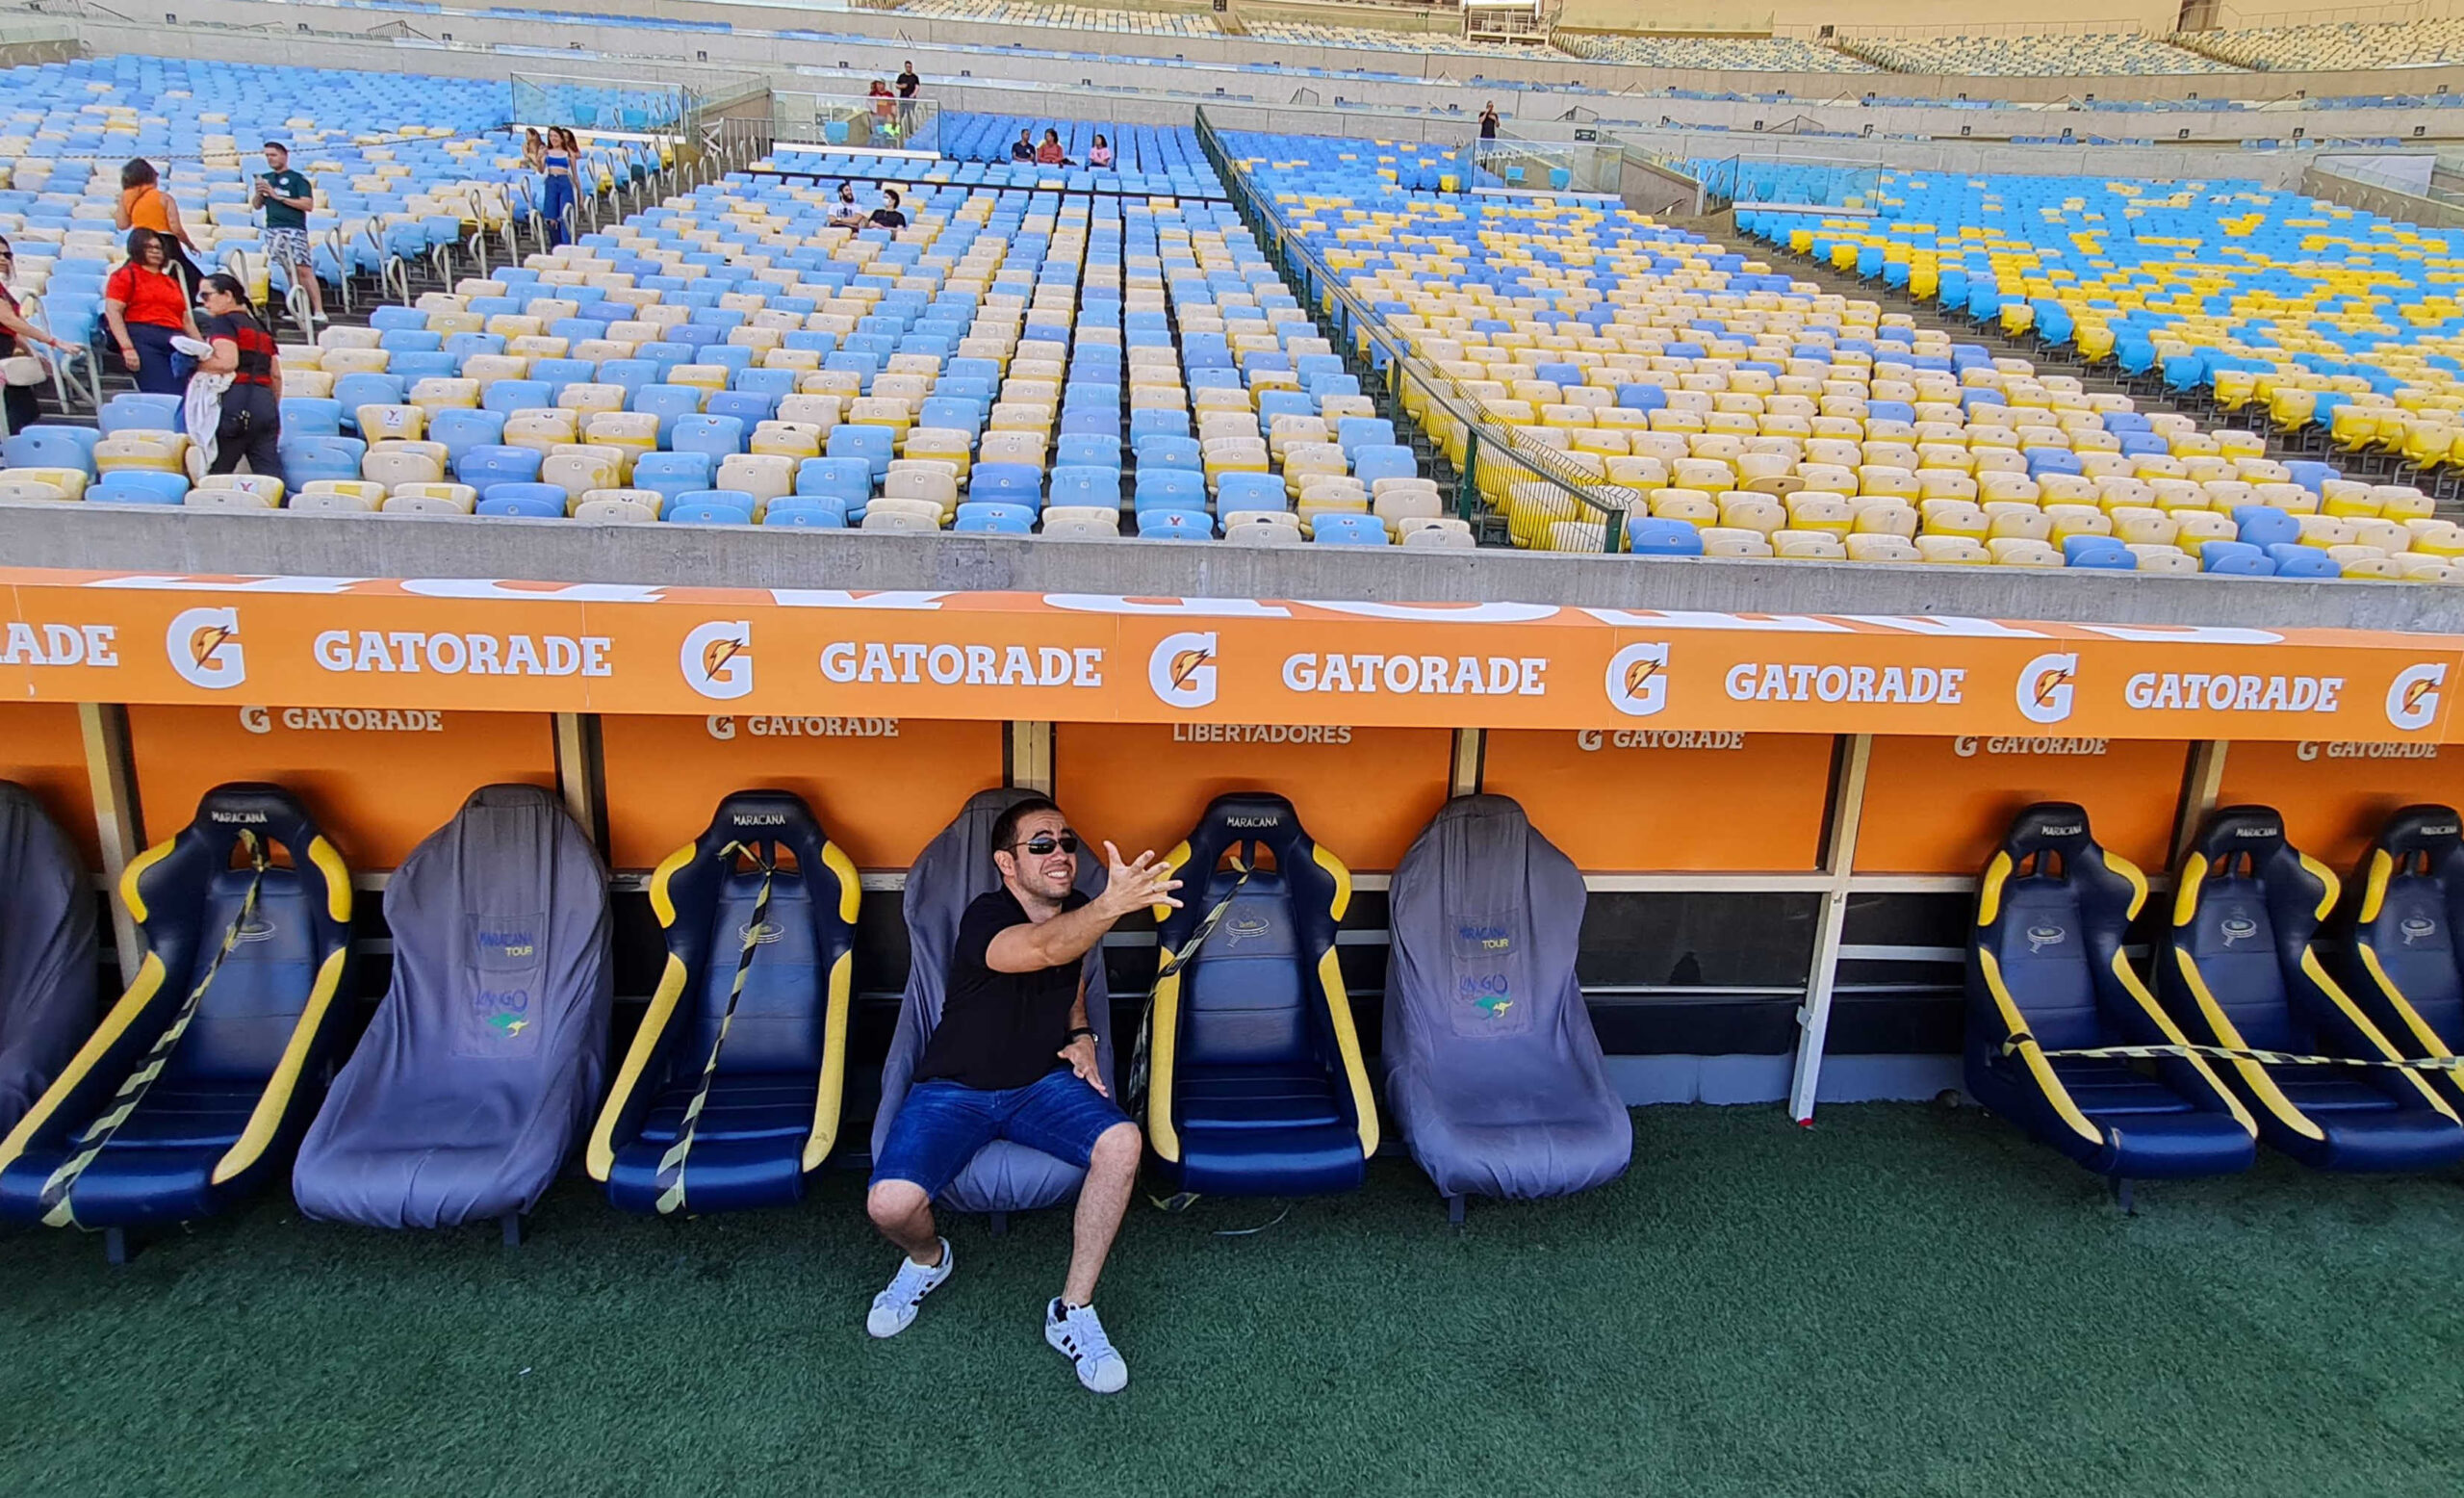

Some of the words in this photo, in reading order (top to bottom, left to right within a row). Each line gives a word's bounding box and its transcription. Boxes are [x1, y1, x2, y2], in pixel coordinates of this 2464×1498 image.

[0, 623, 118, 666] ADE
[167, 607, 245, 688] G
[314, 631, 611, 676] GATORADE
[680, 621, 753, 699] G
[820, 642, 1101, 686] GATORADE
[1149, 632, 1217, 708] G
[1283, 654, 1546, 694] GATORADE
[1605, 642, 1671, 715] G
[1726, 663, 1966, 703] GATORADE
[2016, 653, 2079, 723] G
[2126, 673, 2344, 711] GATORADE
[2386, 663, 2447, 730] G
[284, 709, 442, 731] GATORADE
[747, 715, 899, 736] GATORADE
[1173, 723, 1351, 744] LIBERTADORES
[1613, 730, 1746, 749] GATORADE
[1988, 736, 2109, 755] GATORADE
[2326, 742, 2437, 758] GATORADE
[504, 945, 533, 957] TOUR
[1481, 938, 1509, 949] TOUR
